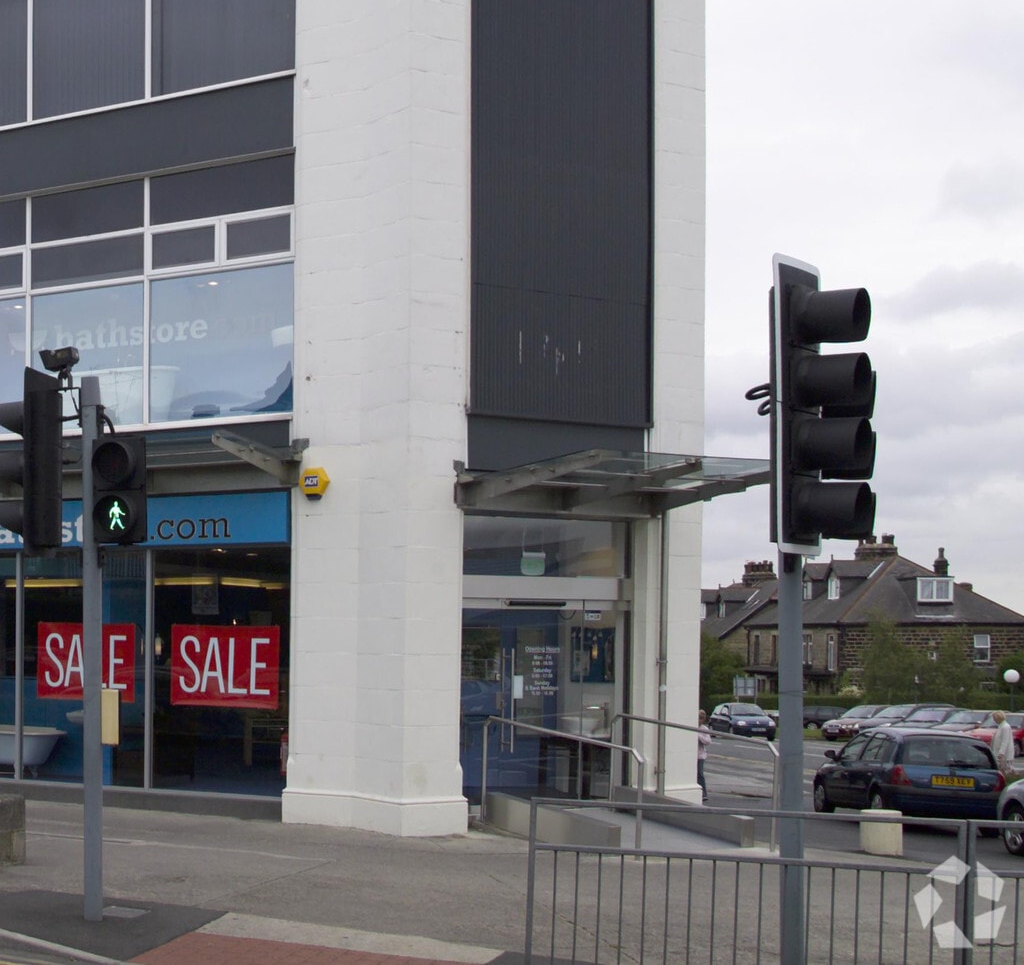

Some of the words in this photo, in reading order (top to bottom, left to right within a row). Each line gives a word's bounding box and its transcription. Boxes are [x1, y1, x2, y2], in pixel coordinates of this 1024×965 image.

[304, 477, 319, 485] ADT
[45, 632, 127, 689] SAE
[179, 635, 271, 695] SALE
[524, 646, 545, 654] Opening
